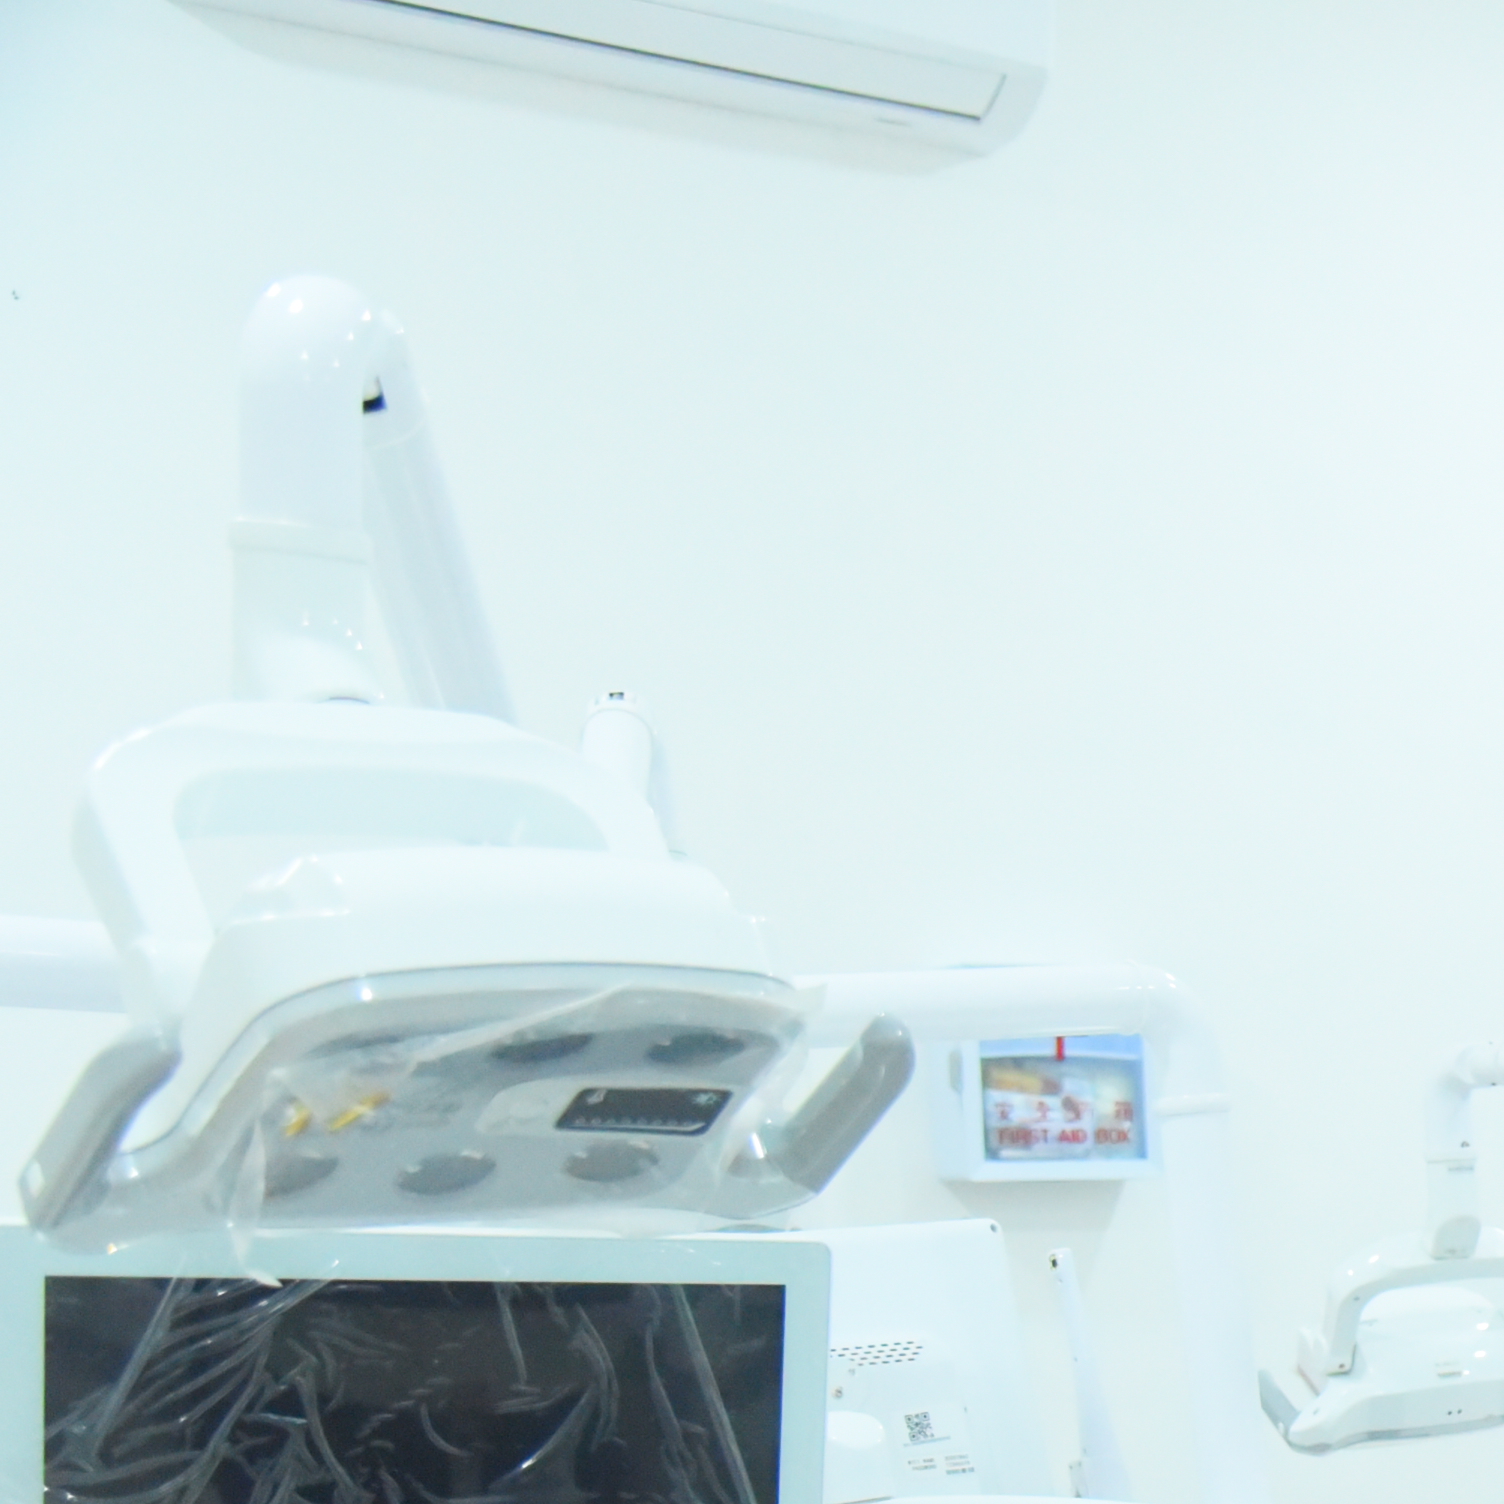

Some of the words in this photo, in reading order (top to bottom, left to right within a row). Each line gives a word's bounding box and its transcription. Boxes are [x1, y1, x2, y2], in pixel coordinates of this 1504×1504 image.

[998, 1128, 1049, 1145] FIRST
[1059, 1128, 1087, 1145] AID
[1095, 1128, 1131, 1145] BOX
